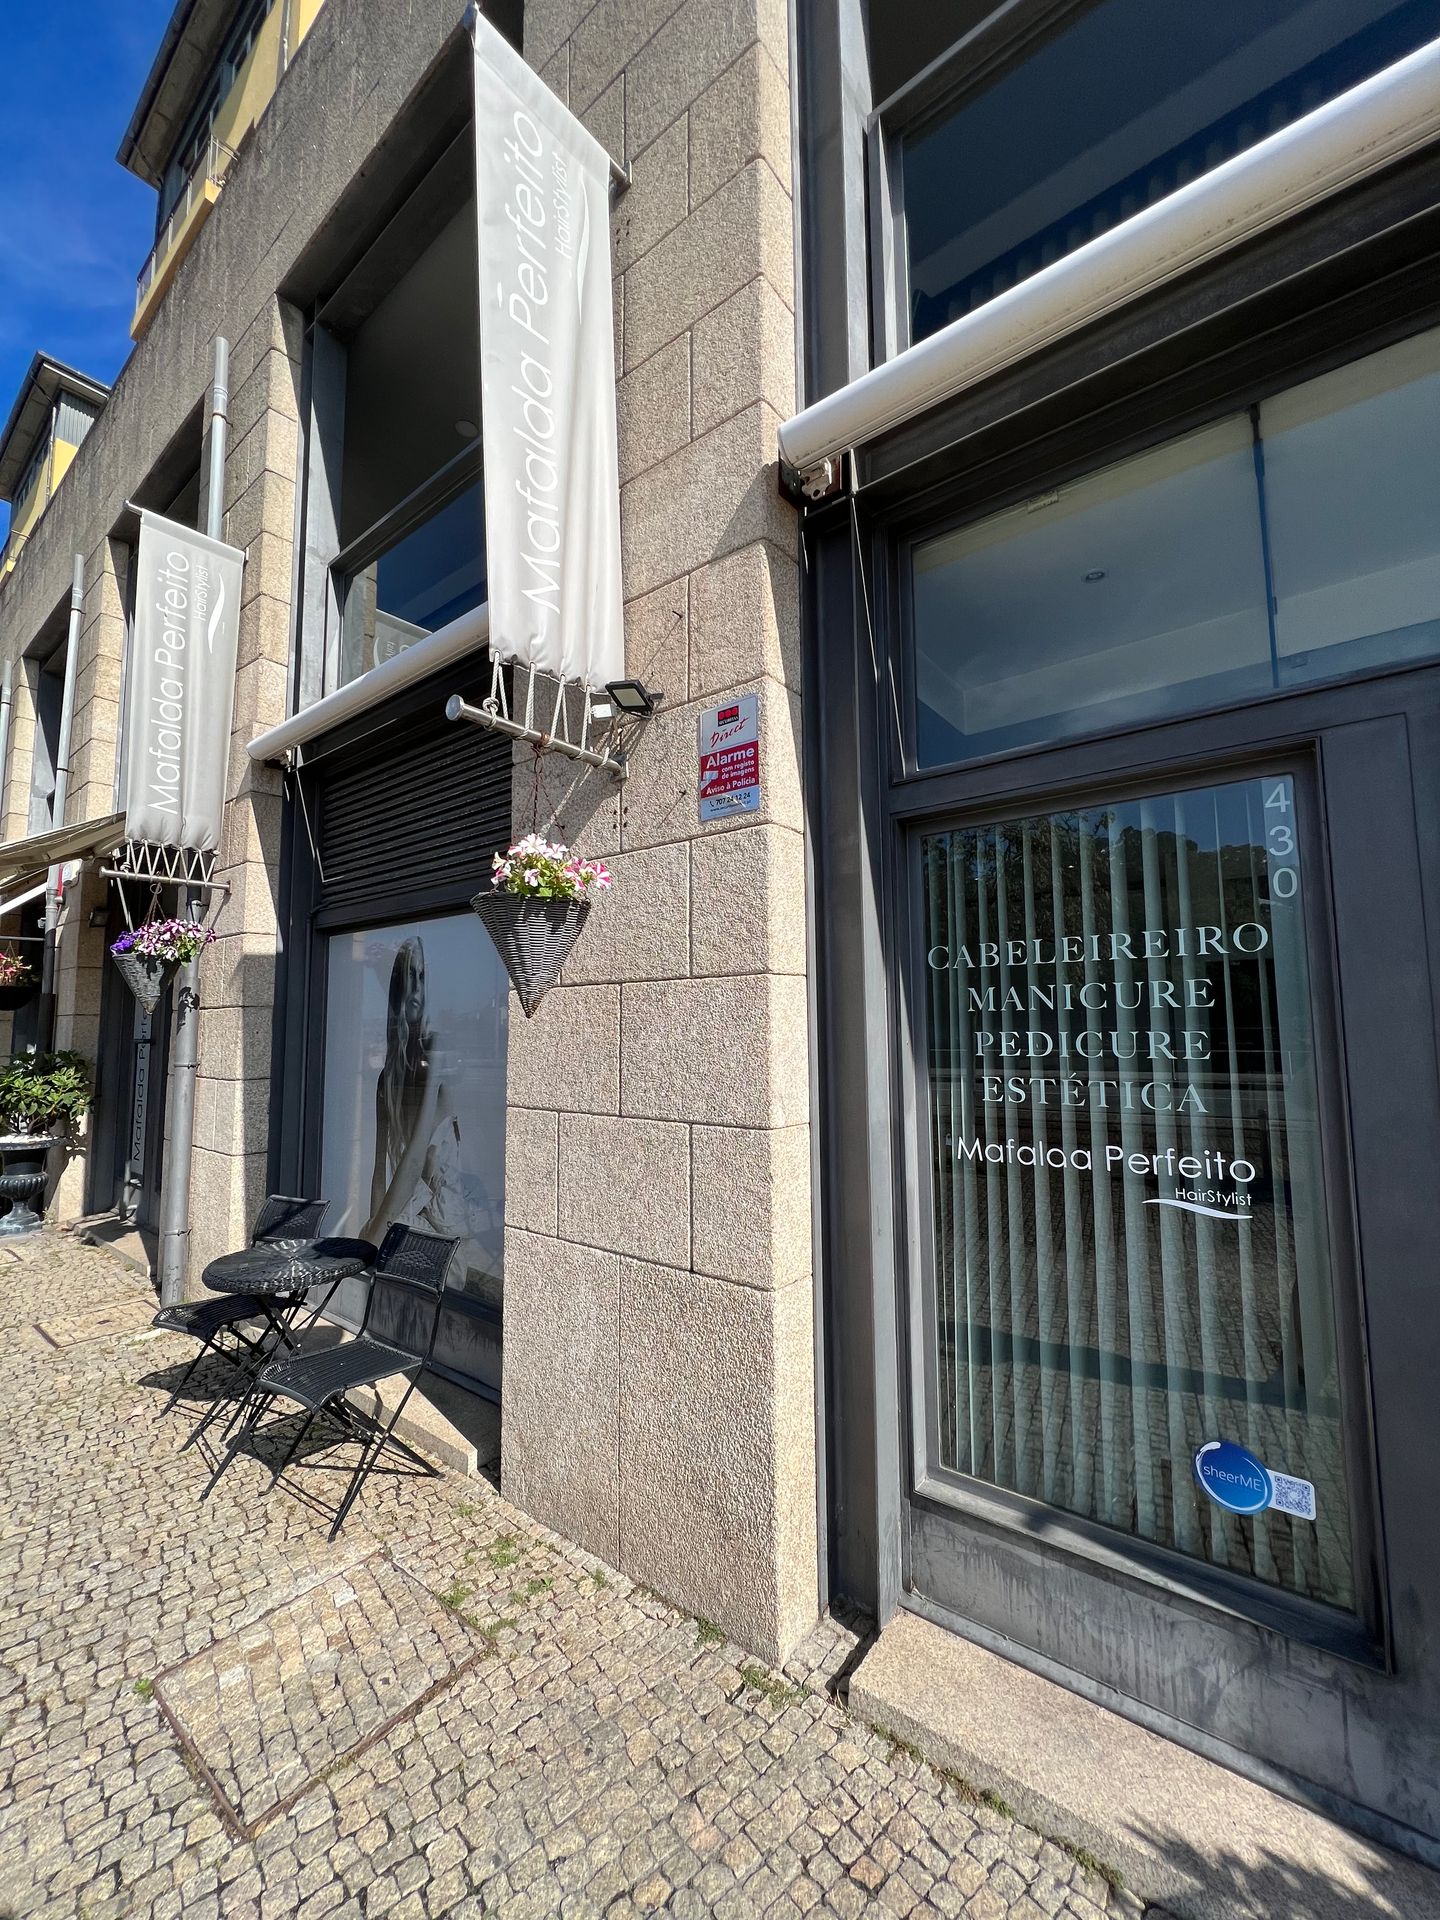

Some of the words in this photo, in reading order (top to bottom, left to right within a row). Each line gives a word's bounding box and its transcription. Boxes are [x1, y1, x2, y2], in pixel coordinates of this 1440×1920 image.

[552, 151, 572, 259] HairStylist
[503, 111, 549, 342] Perfeito
[511, 355, 560, 615] Mafalda
[154, 551, 190, 669] Perfeito
[193, 565, 208, 622] HairStylist
[147, 677, 184, 815] Mafalda
[706, 747, 755, 769] Alarme
[721, 765, 733, 773] com
[734, 760, 755, 769] registo
[706, 785, 725, 795] Aviso
[730, 767, 755, 777] imagens
[1264, 782, 1298, 899] 430
[927, 922, 1268, 970] CABELEIREIRO
[967, 978, 1216, 1012] MANICURE
[975, 1031, 1211, 1062] PEDICURE
[982, 1072, 1208, 1114] ESTÉTICA
[134, 1068, 144, 1161] Mafalda
[1105, 1145, 1256, 1183] Perfeito
[1175, 1187, 1252, 1207] HairStylist
[1203, 1465, 1262, 1492] sheerME
